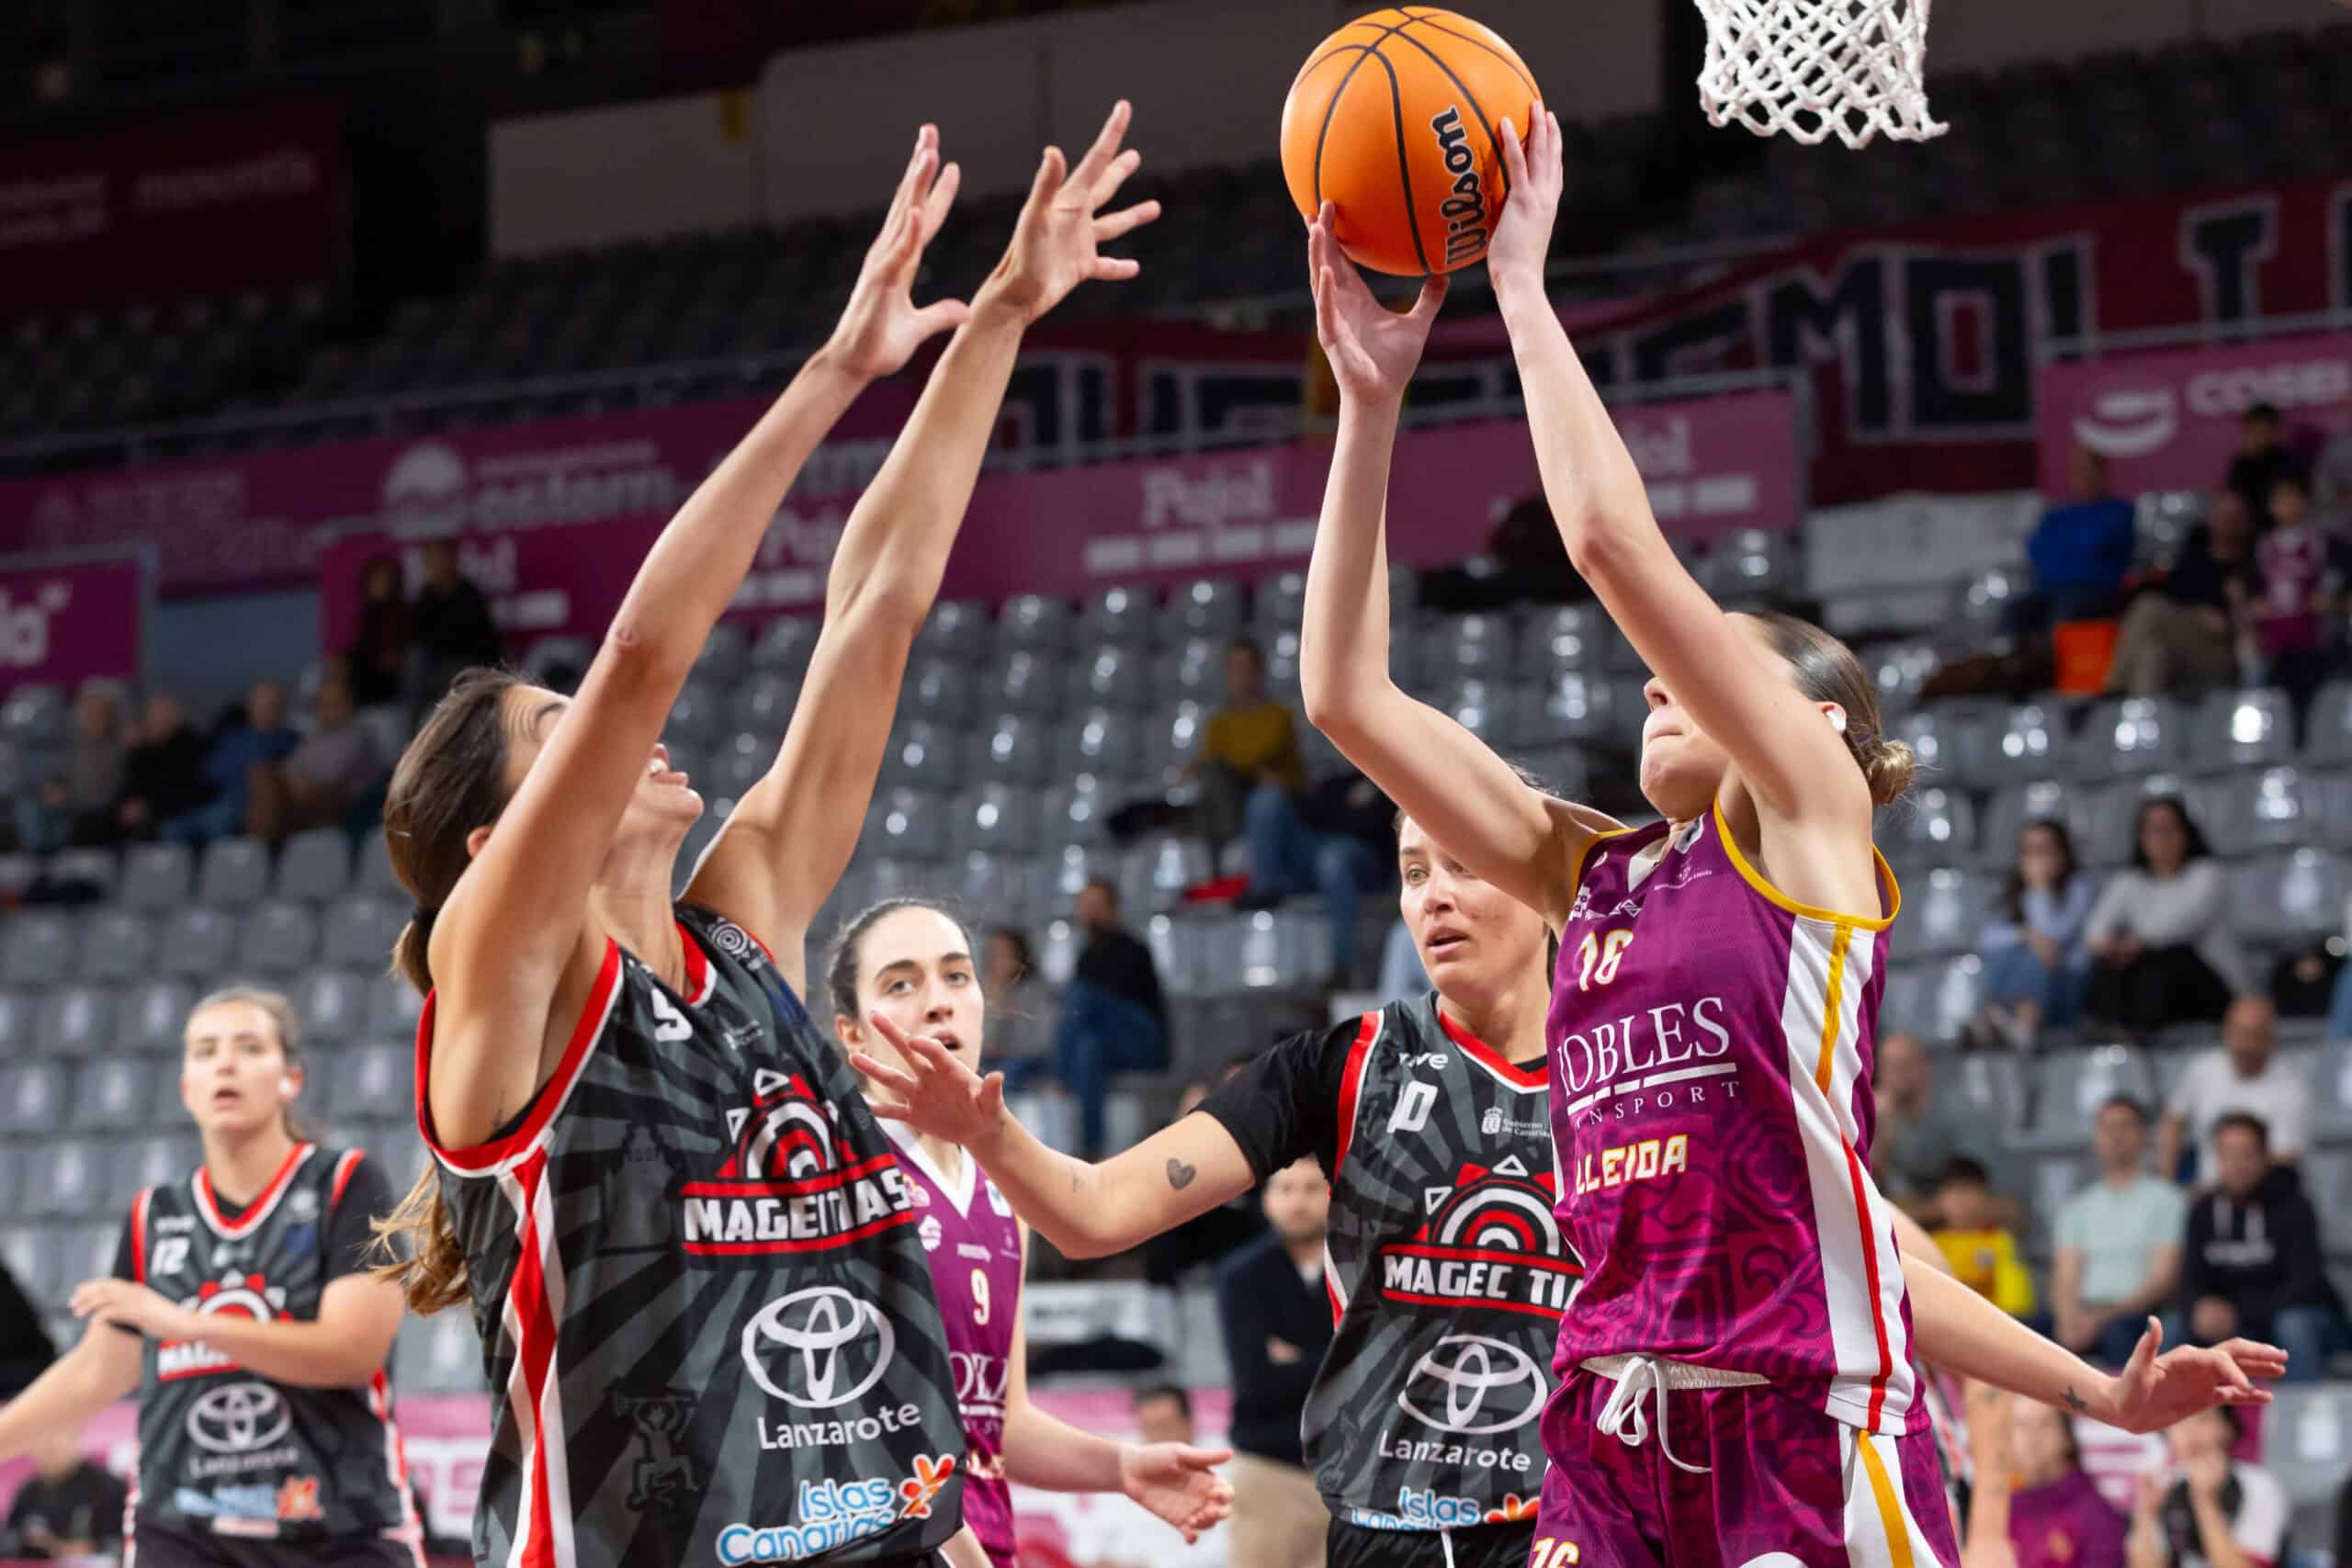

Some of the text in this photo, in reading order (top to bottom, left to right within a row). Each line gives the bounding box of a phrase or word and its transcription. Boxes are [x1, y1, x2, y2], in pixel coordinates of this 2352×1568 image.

[1431, 105, 1487, 266] Wilson
[970, 1268, 990, 1326] 9
[1384, 1255, 1513, 1300] MAGEC
[756, 1403, 922, 1450] Lanzarote
[1379, 1429, 1532, 1472] Lanzarote
[797, 1478, 896, 1521] Islas
[1398, 1485, 1480, 1526] Islas
